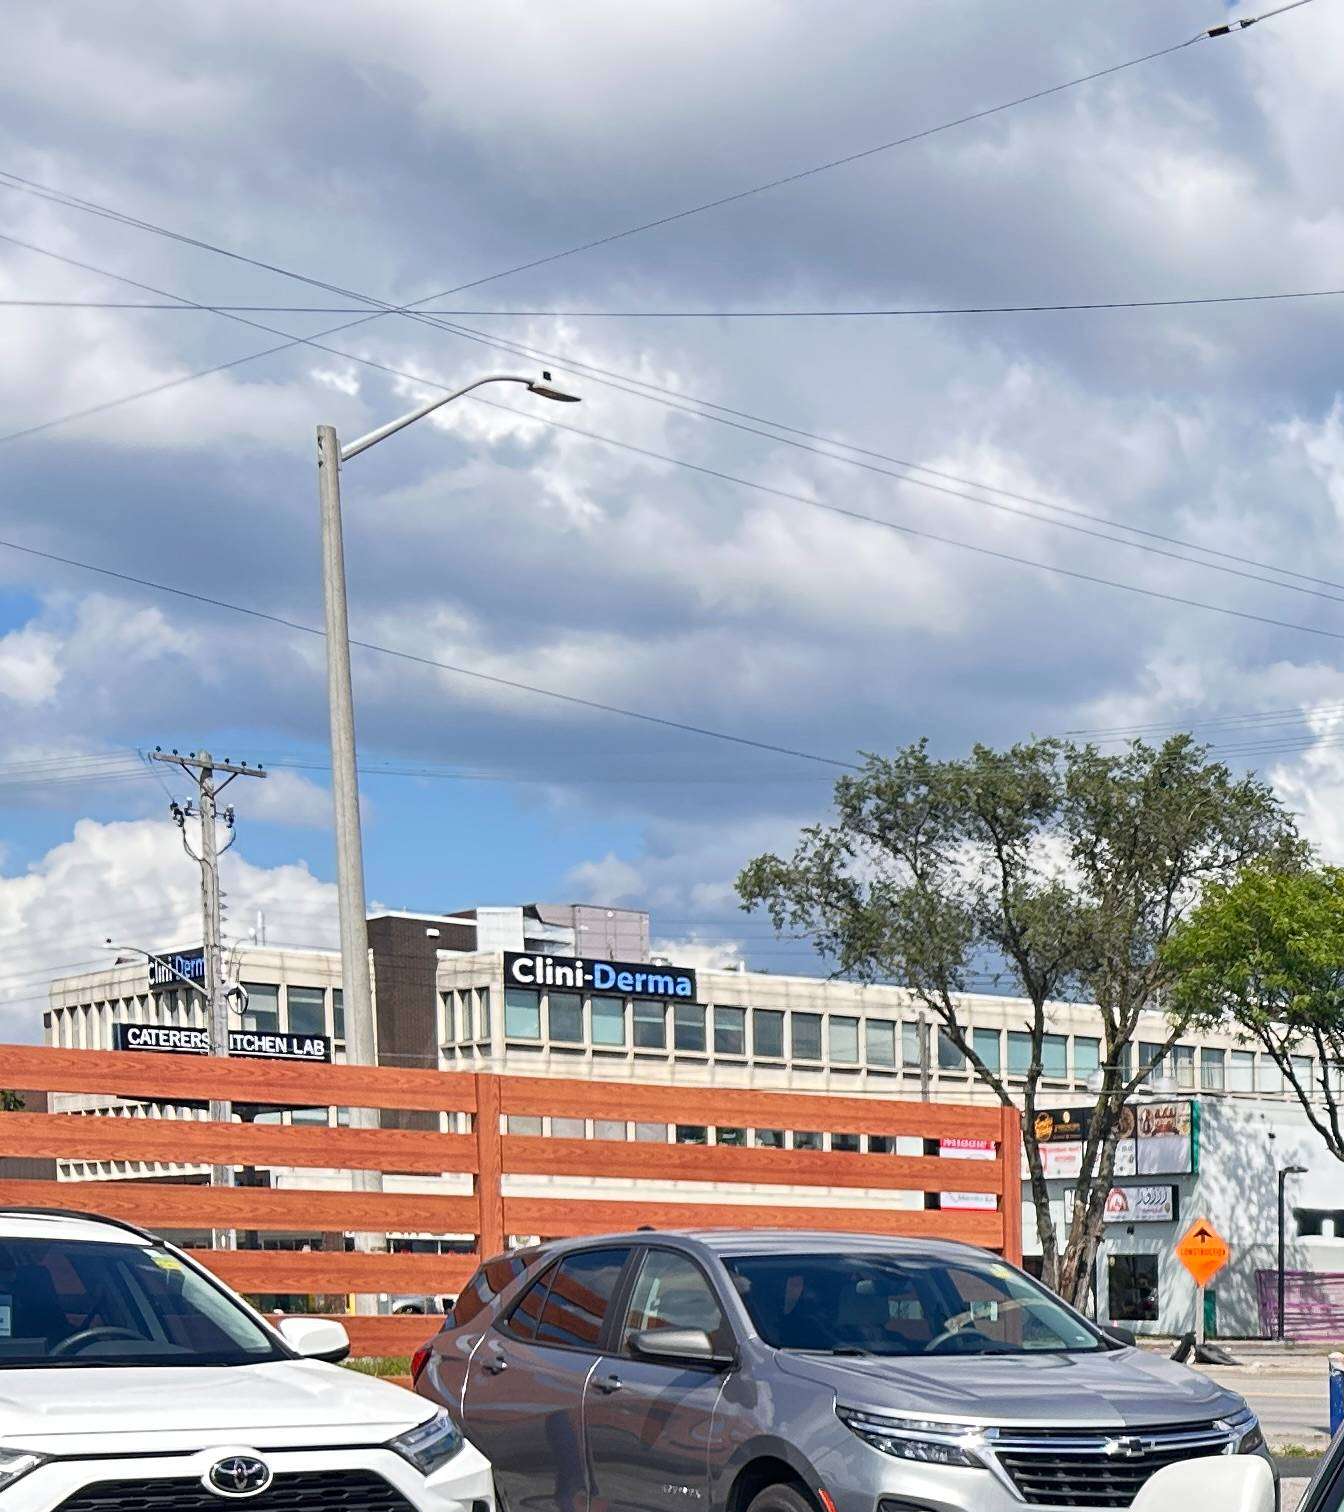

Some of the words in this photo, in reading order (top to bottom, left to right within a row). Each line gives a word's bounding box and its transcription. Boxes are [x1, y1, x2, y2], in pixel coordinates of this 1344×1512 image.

[512, 957, 692, 997] Clini-Derma
[127, 1028, 209, 1048] CATERERS
[228, 1033, 288, 1054] ITCHEN
[292, 1038, 325, 1056] LAB
